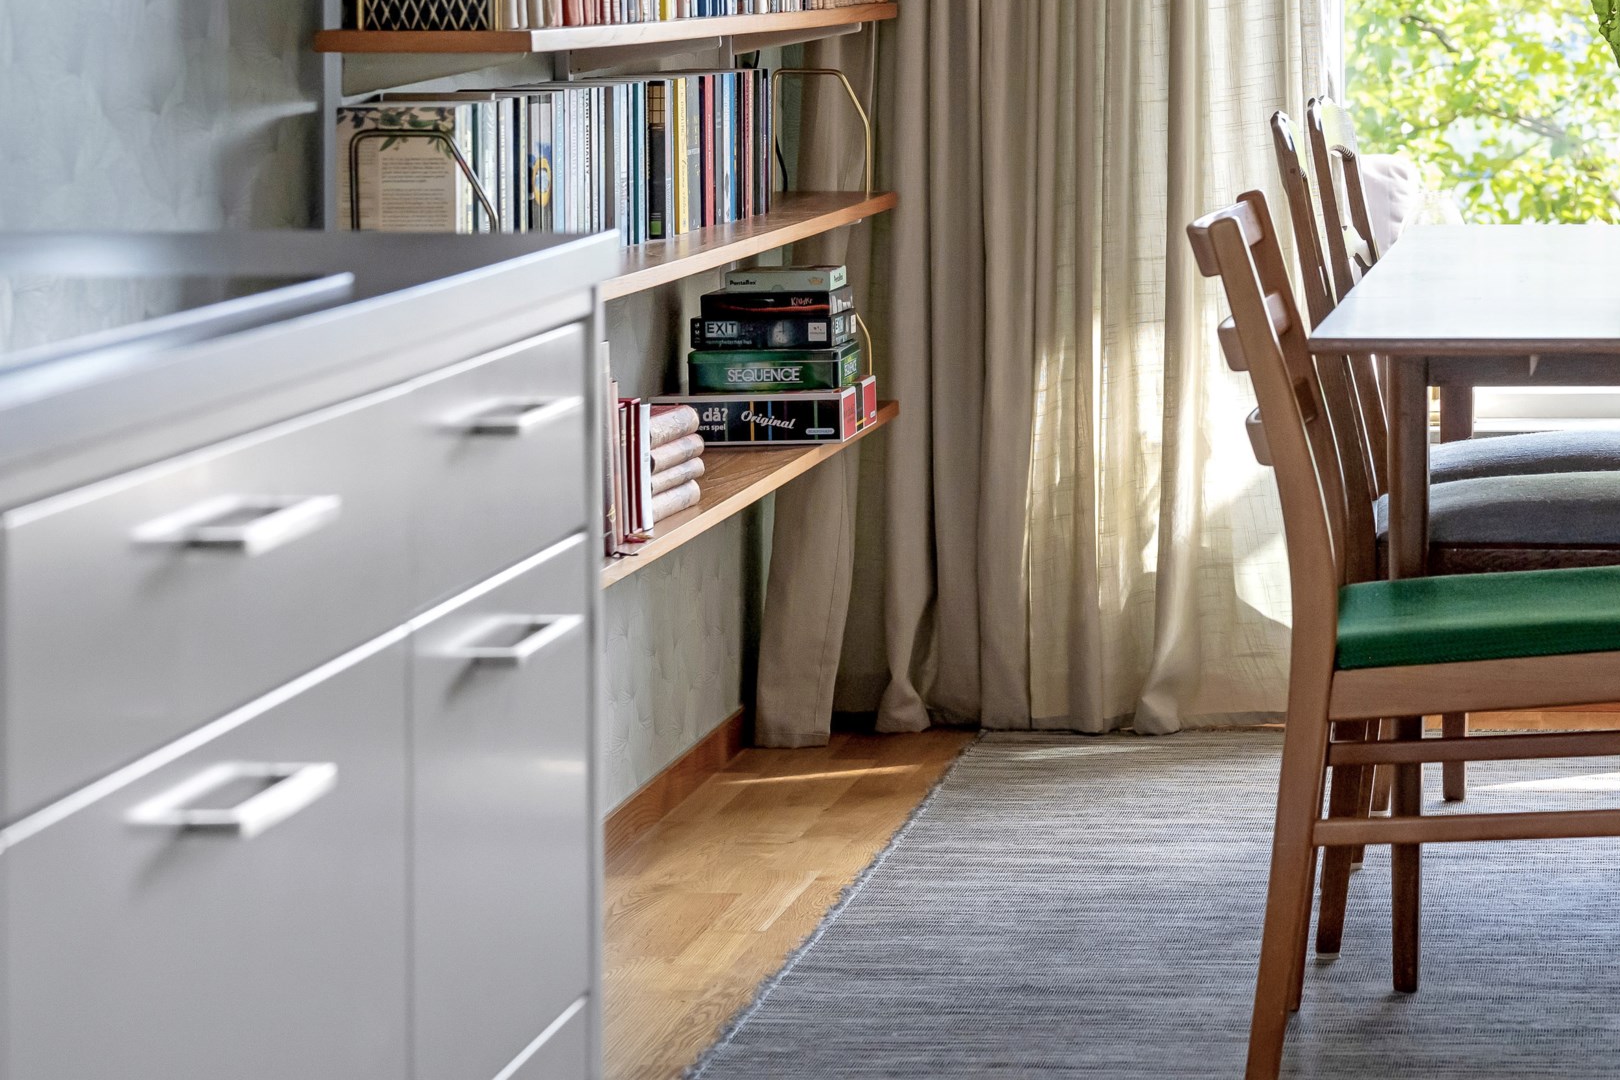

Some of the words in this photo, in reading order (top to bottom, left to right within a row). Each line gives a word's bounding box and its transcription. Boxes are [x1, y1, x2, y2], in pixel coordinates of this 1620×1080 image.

[706, 322, 737, 336] EXIT
[727, 368, 800, 383] SEQUENCE
[702, 407, 729, 422] då?
[741, 410, 796, 430] Original
[710, 423, 726, 432] spel
